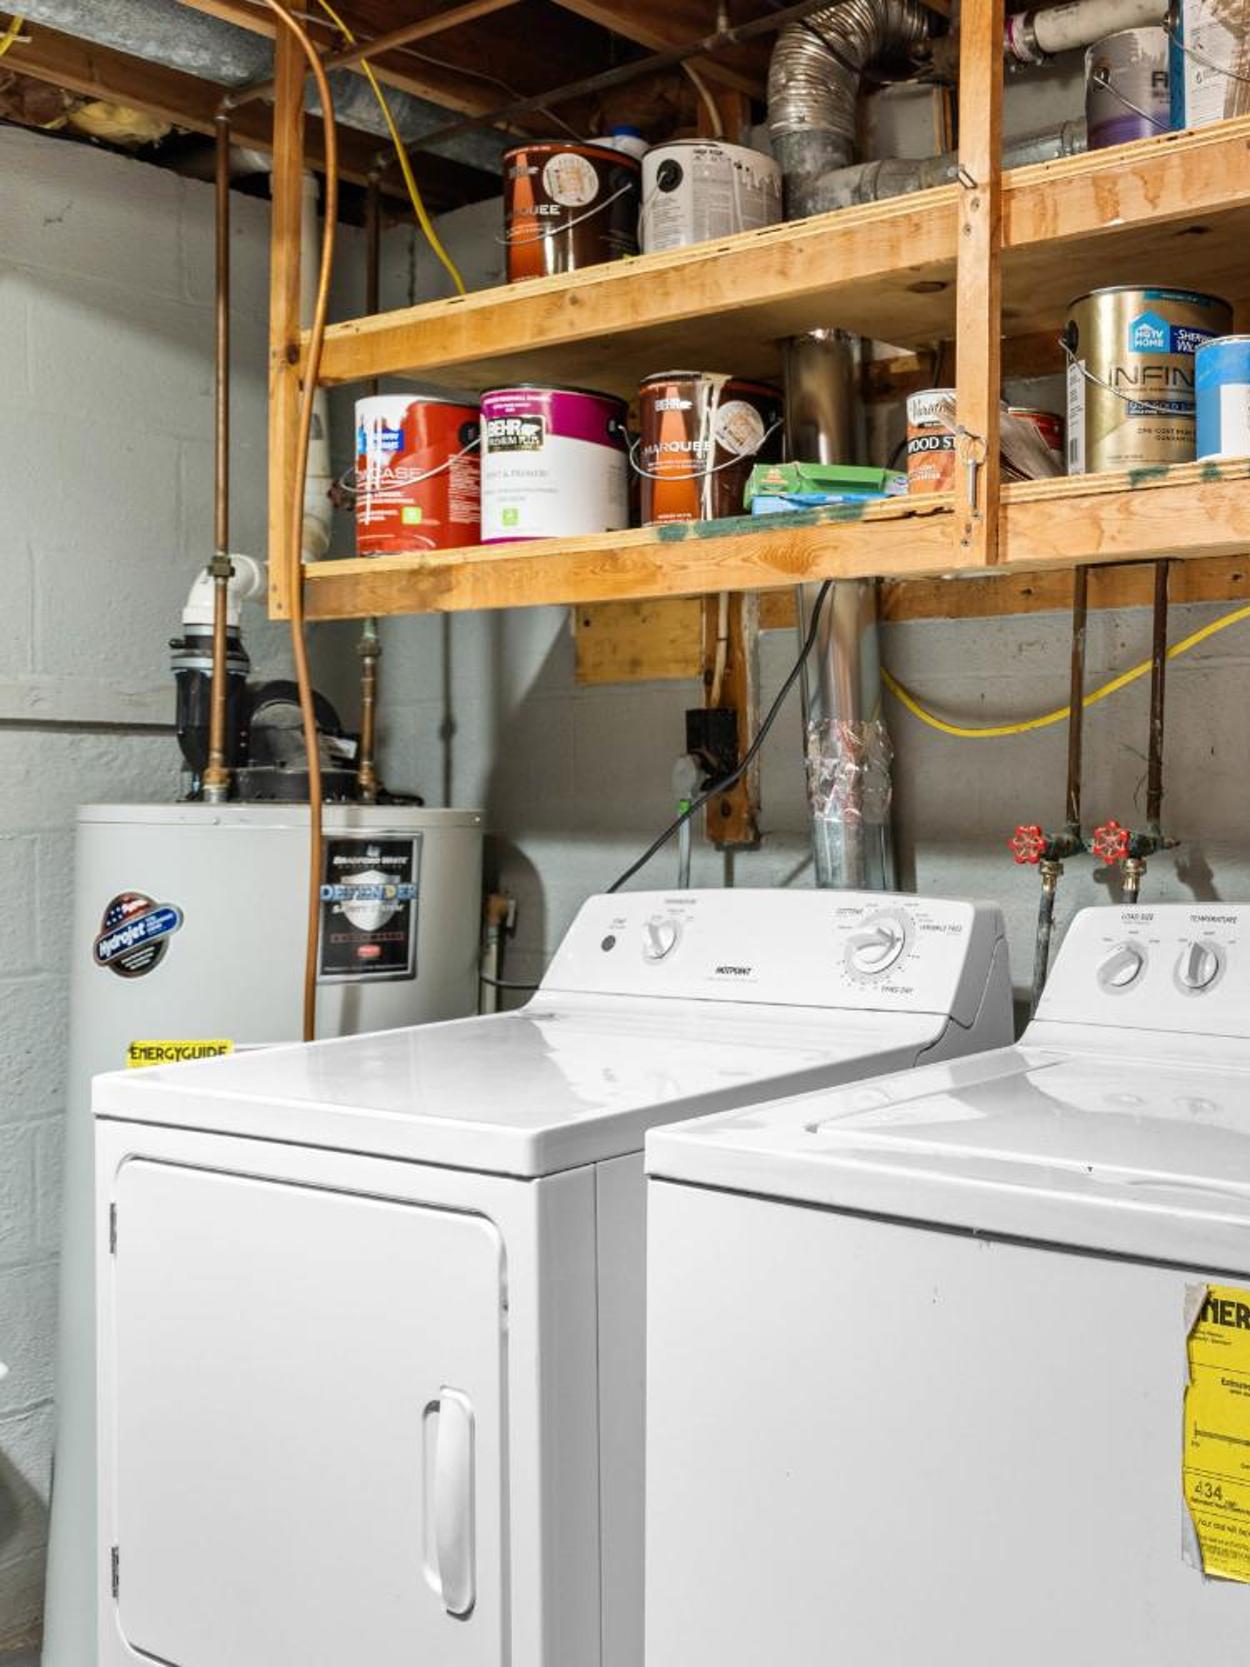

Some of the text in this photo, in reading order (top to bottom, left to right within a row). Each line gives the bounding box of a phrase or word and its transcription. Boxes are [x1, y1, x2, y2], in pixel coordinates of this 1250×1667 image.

[1134, 338, 1164, 348] HOME
[487, 419, 522, 437] BEHR
[643, 441, 712, 455] MARQUEE
[320, 883, 418, 901] DEFENDER
[99, 921, 146, 958] Hydrojet
[715, 966, 752, 976] HOTPOINT
[128, 1045, 228, 1062] ENERGYGUIDE
[1195, 1481, 1223, 1501] 434
